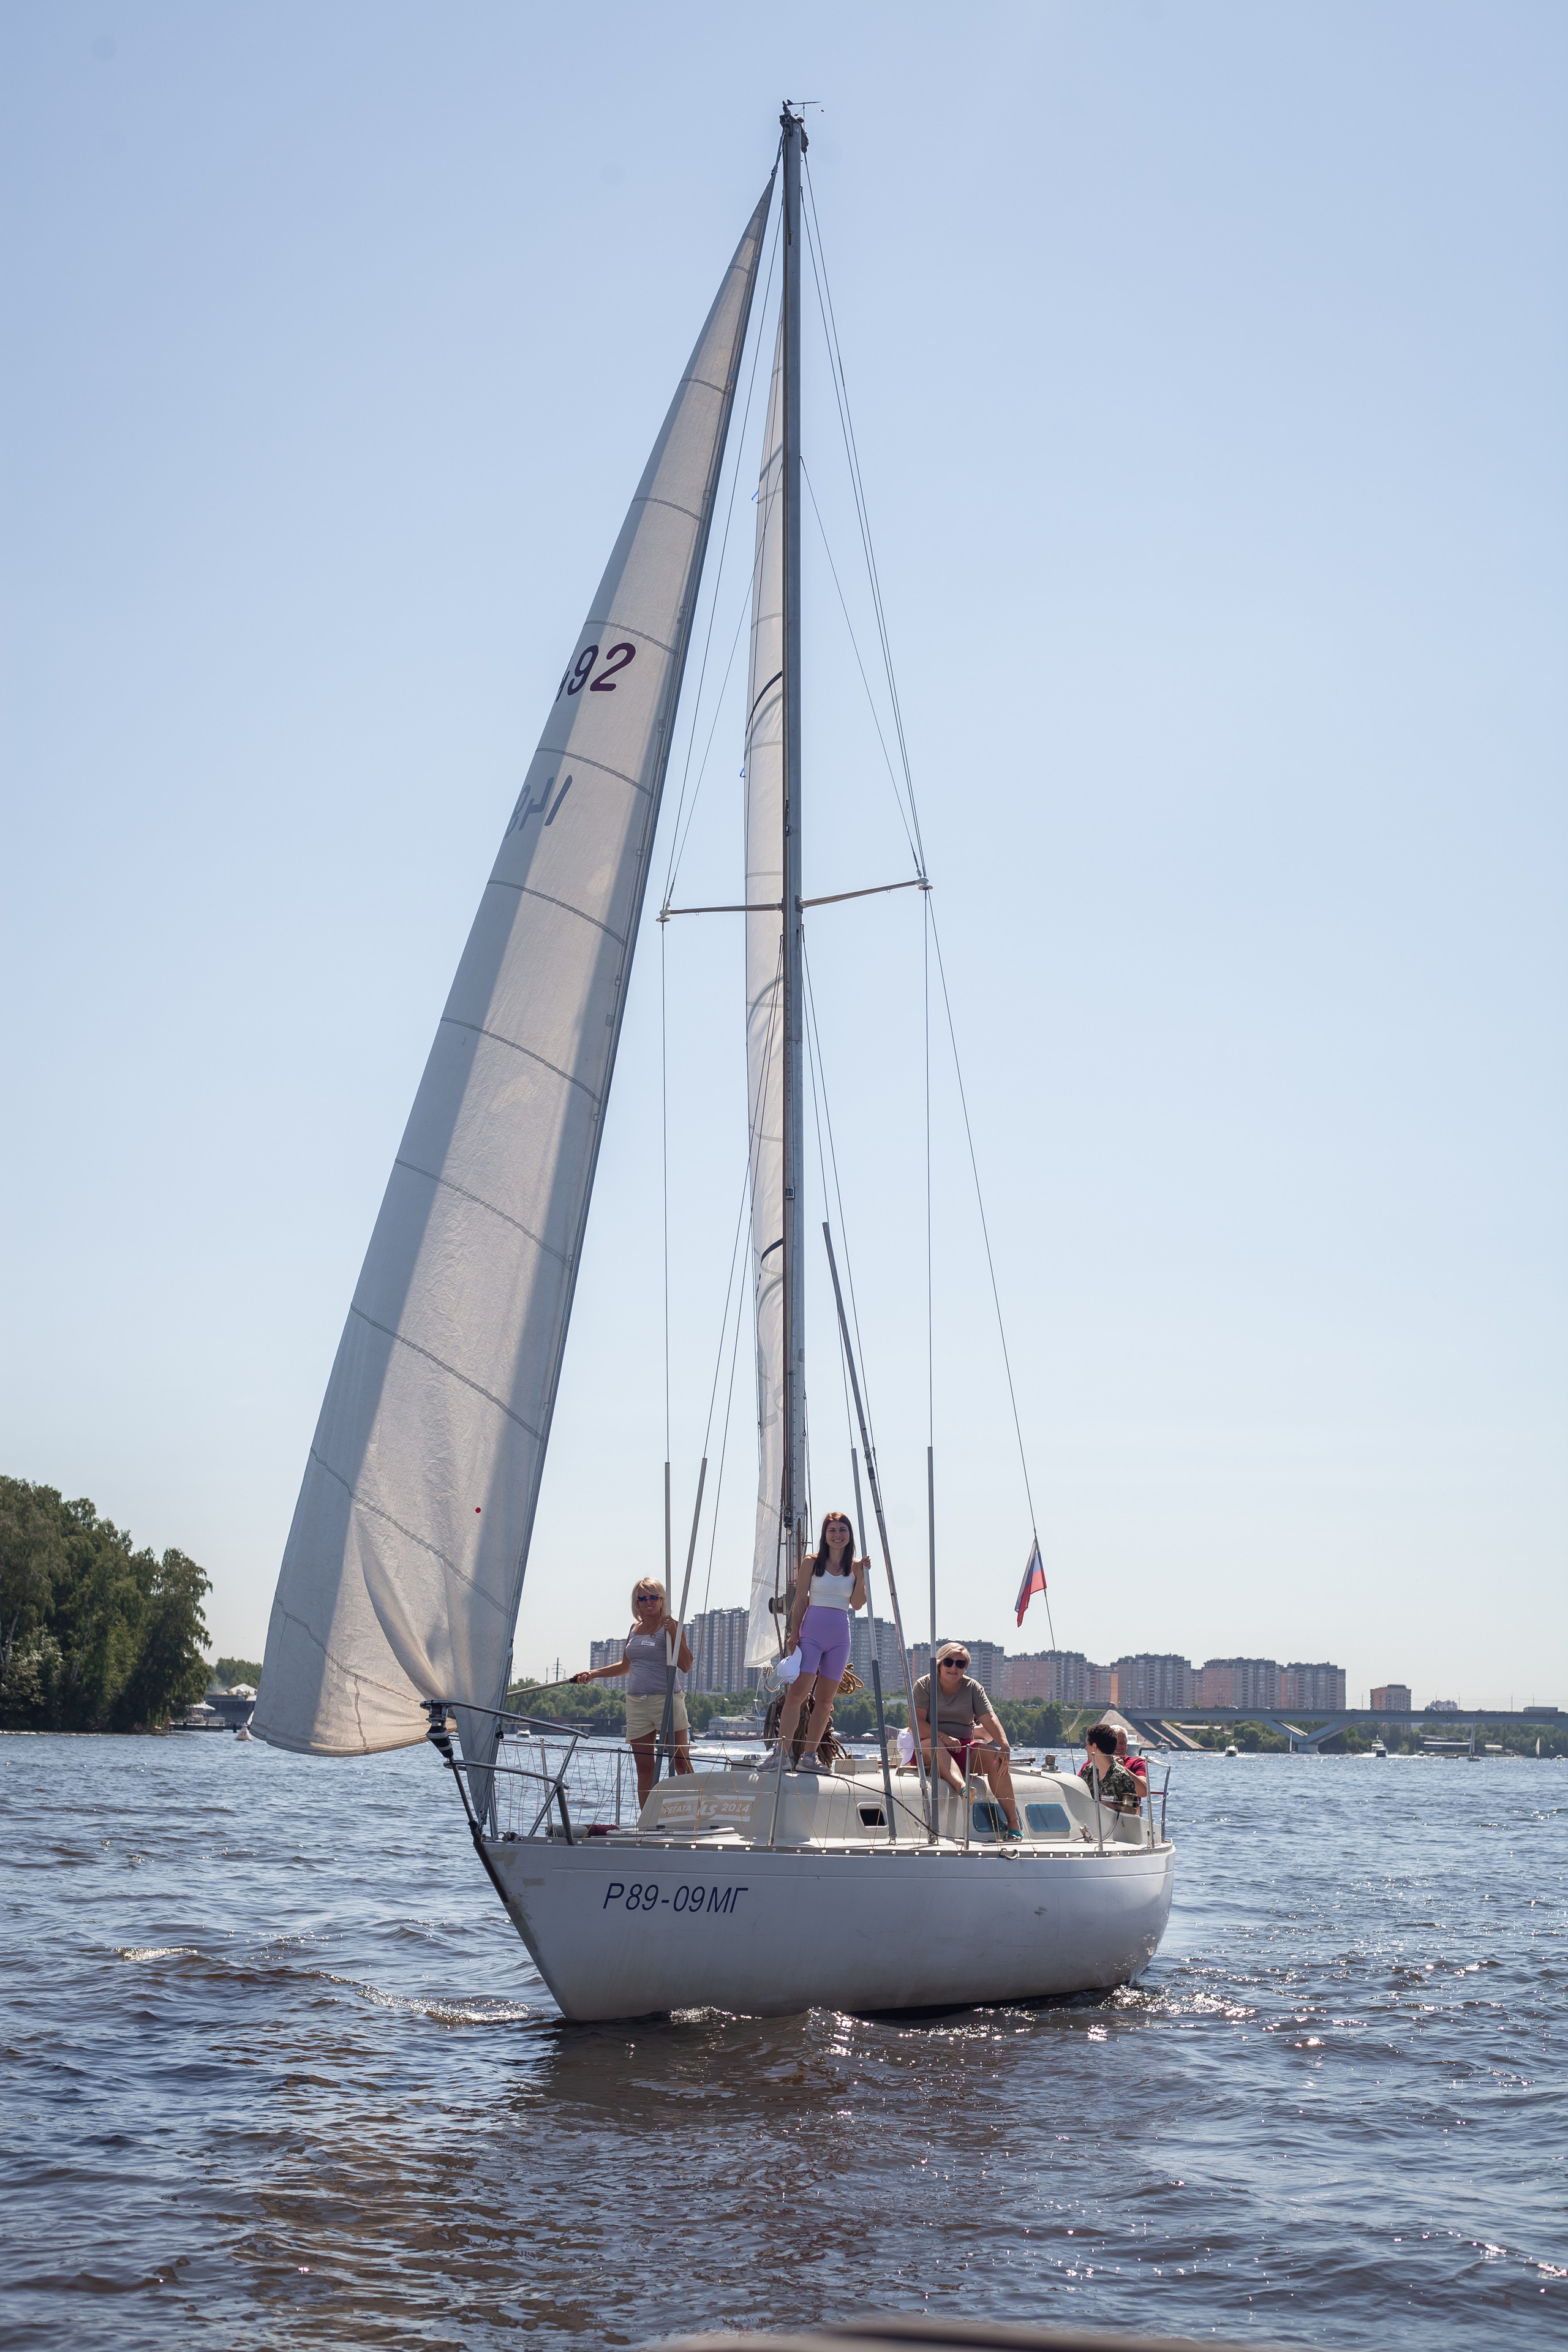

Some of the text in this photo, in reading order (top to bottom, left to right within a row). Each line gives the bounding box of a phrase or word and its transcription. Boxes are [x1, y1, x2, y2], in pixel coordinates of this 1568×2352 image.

[663, 1804, 692, 1814] РЕГАТА
[721, 1803, 750, 1813] 2014
[603, 1883, 749, 1913] Р89-09МГ
